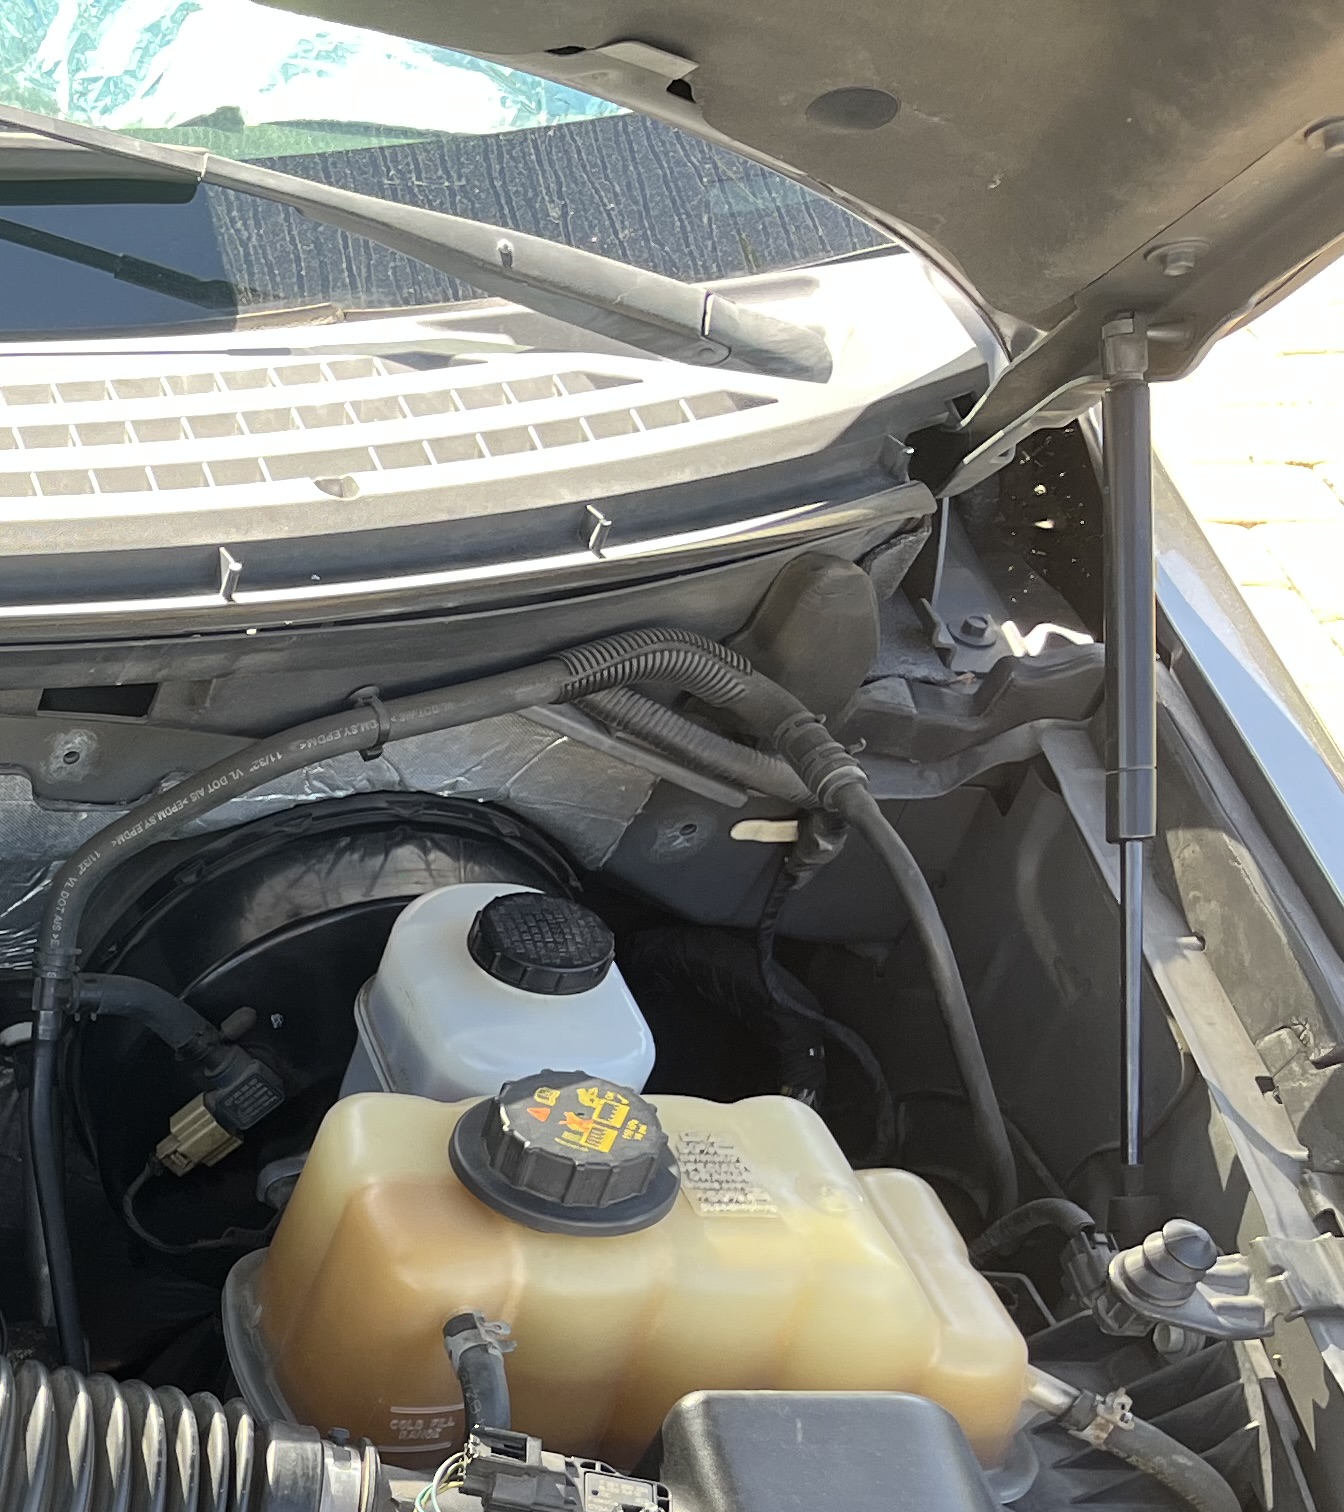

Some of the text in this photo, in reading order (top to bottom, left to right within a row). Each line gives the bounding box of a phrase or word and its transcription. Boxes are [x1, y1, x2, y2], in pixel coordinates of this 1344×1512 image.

[227, 767, 244, 781] VL
[204, 774, 229, 793] DOT
[64, 877, 77, 889] VL
[55, 890, 69, 913] DOT
[389, 1419, 423, 1430] COLD
